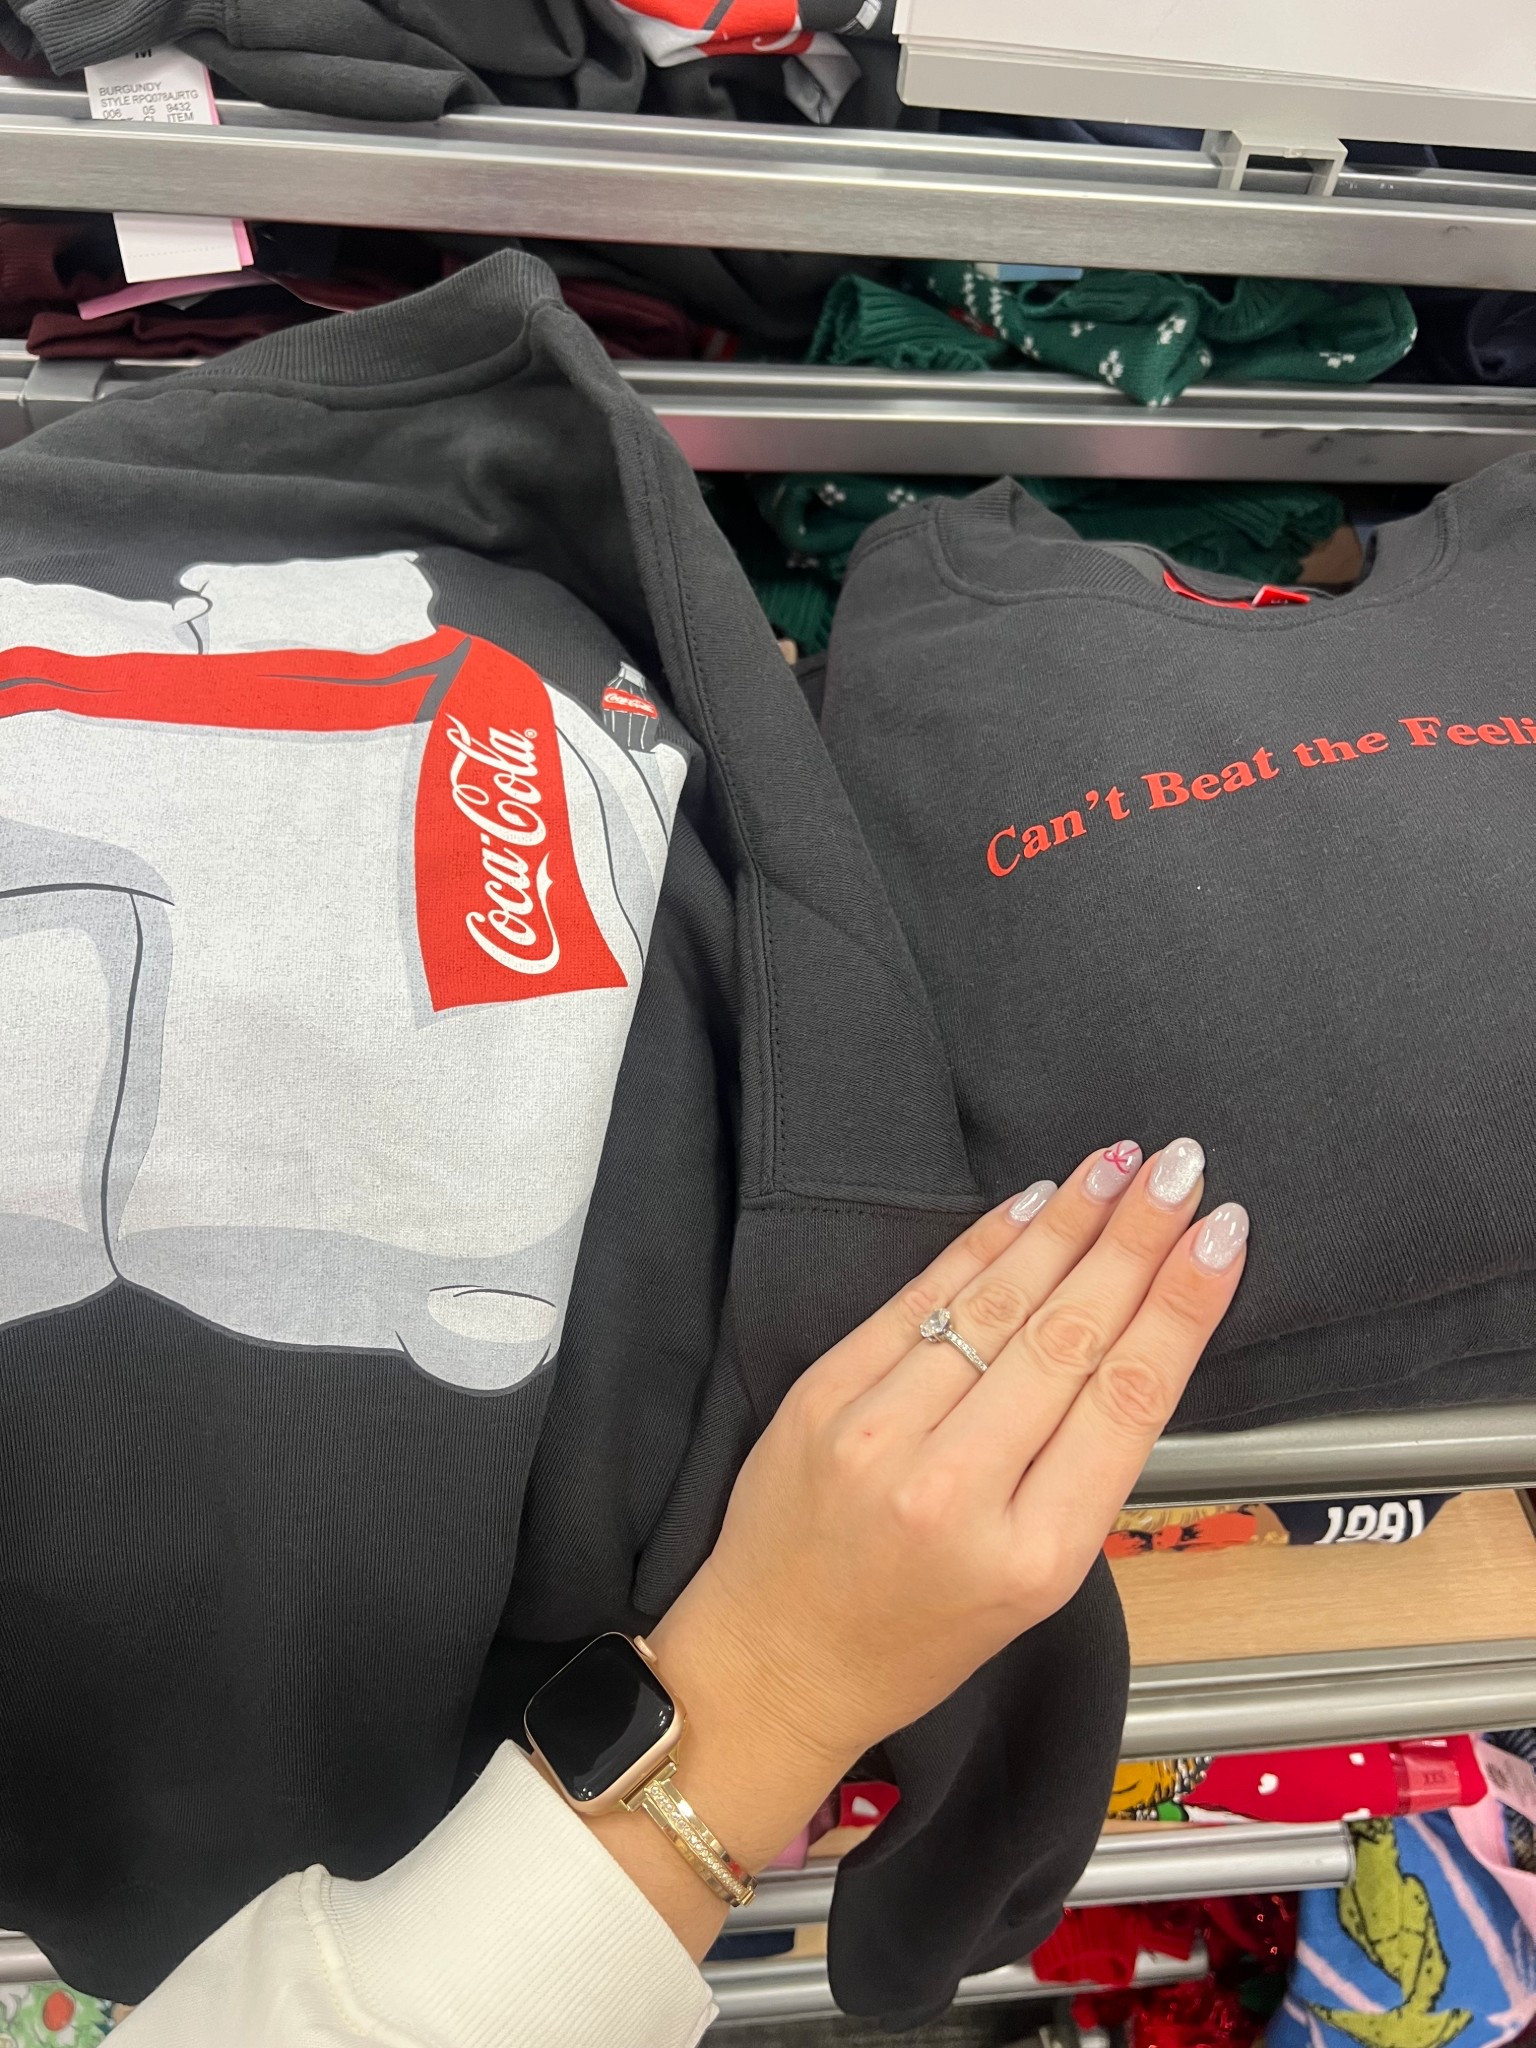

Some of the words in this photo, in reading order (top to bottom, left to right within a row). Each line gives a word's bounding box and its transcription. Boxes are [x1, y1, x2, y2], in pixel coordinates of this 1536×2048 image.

[98, 82, 162, 97] BURGUNDY
[100, 96, 131, 108] STYLE
[142, 105, 156, 116] 05
[166, 111, 195, 123] ITEM
[1140, 746, 1280, 811] Beat
[1292, 732, 1390, 768] the
